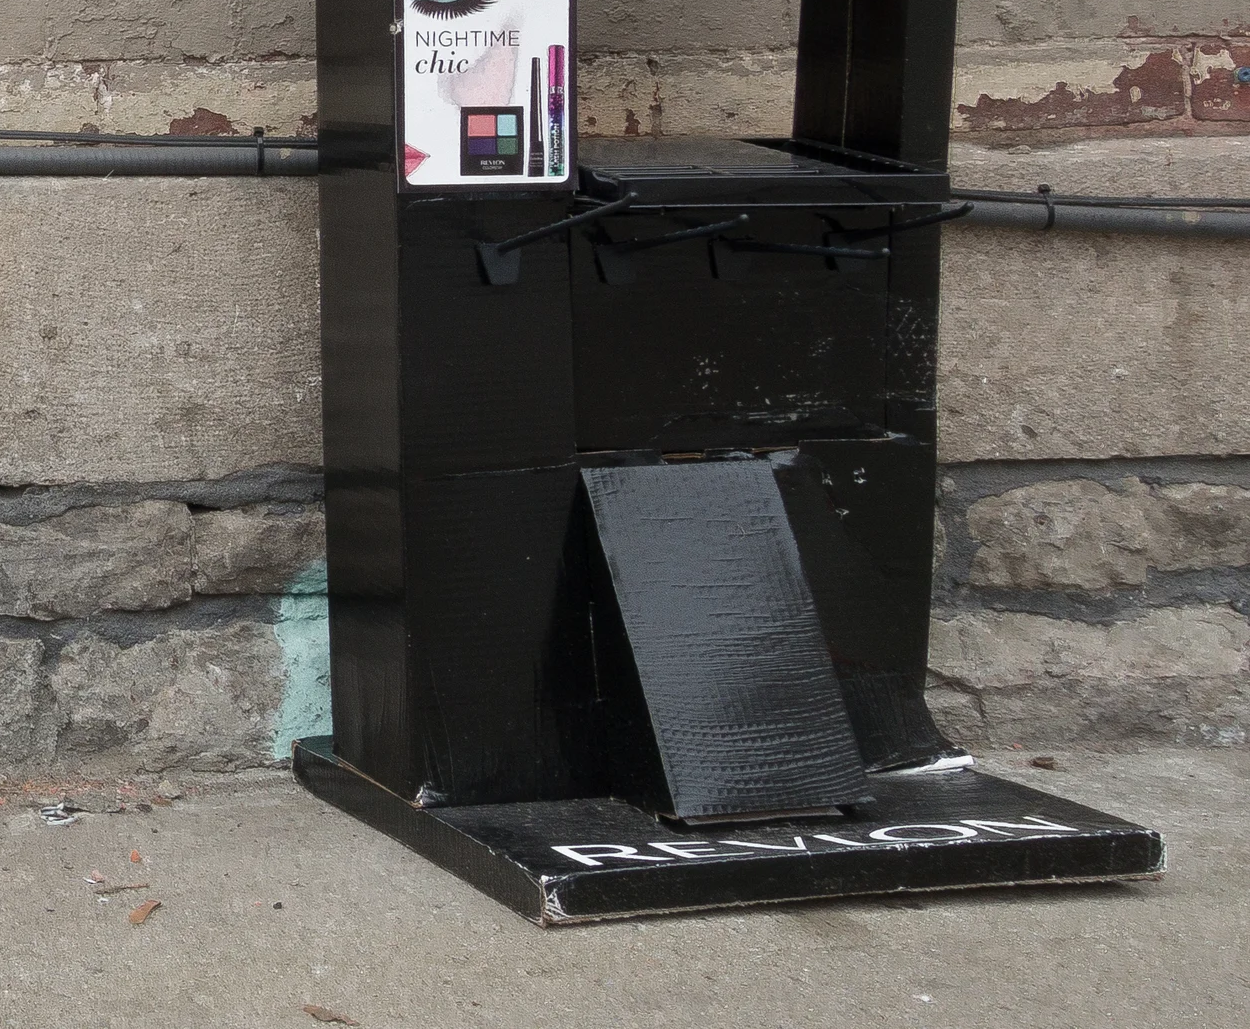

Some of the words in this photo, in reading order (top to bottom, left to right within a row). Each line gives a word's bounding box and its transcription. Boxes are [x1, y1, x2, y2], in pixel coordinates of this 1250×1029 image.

[415, 30, 521, 47] NIGHTIME
[414, 50, 470, 75] chic
[550, 816, 1080, 866] REVLON
